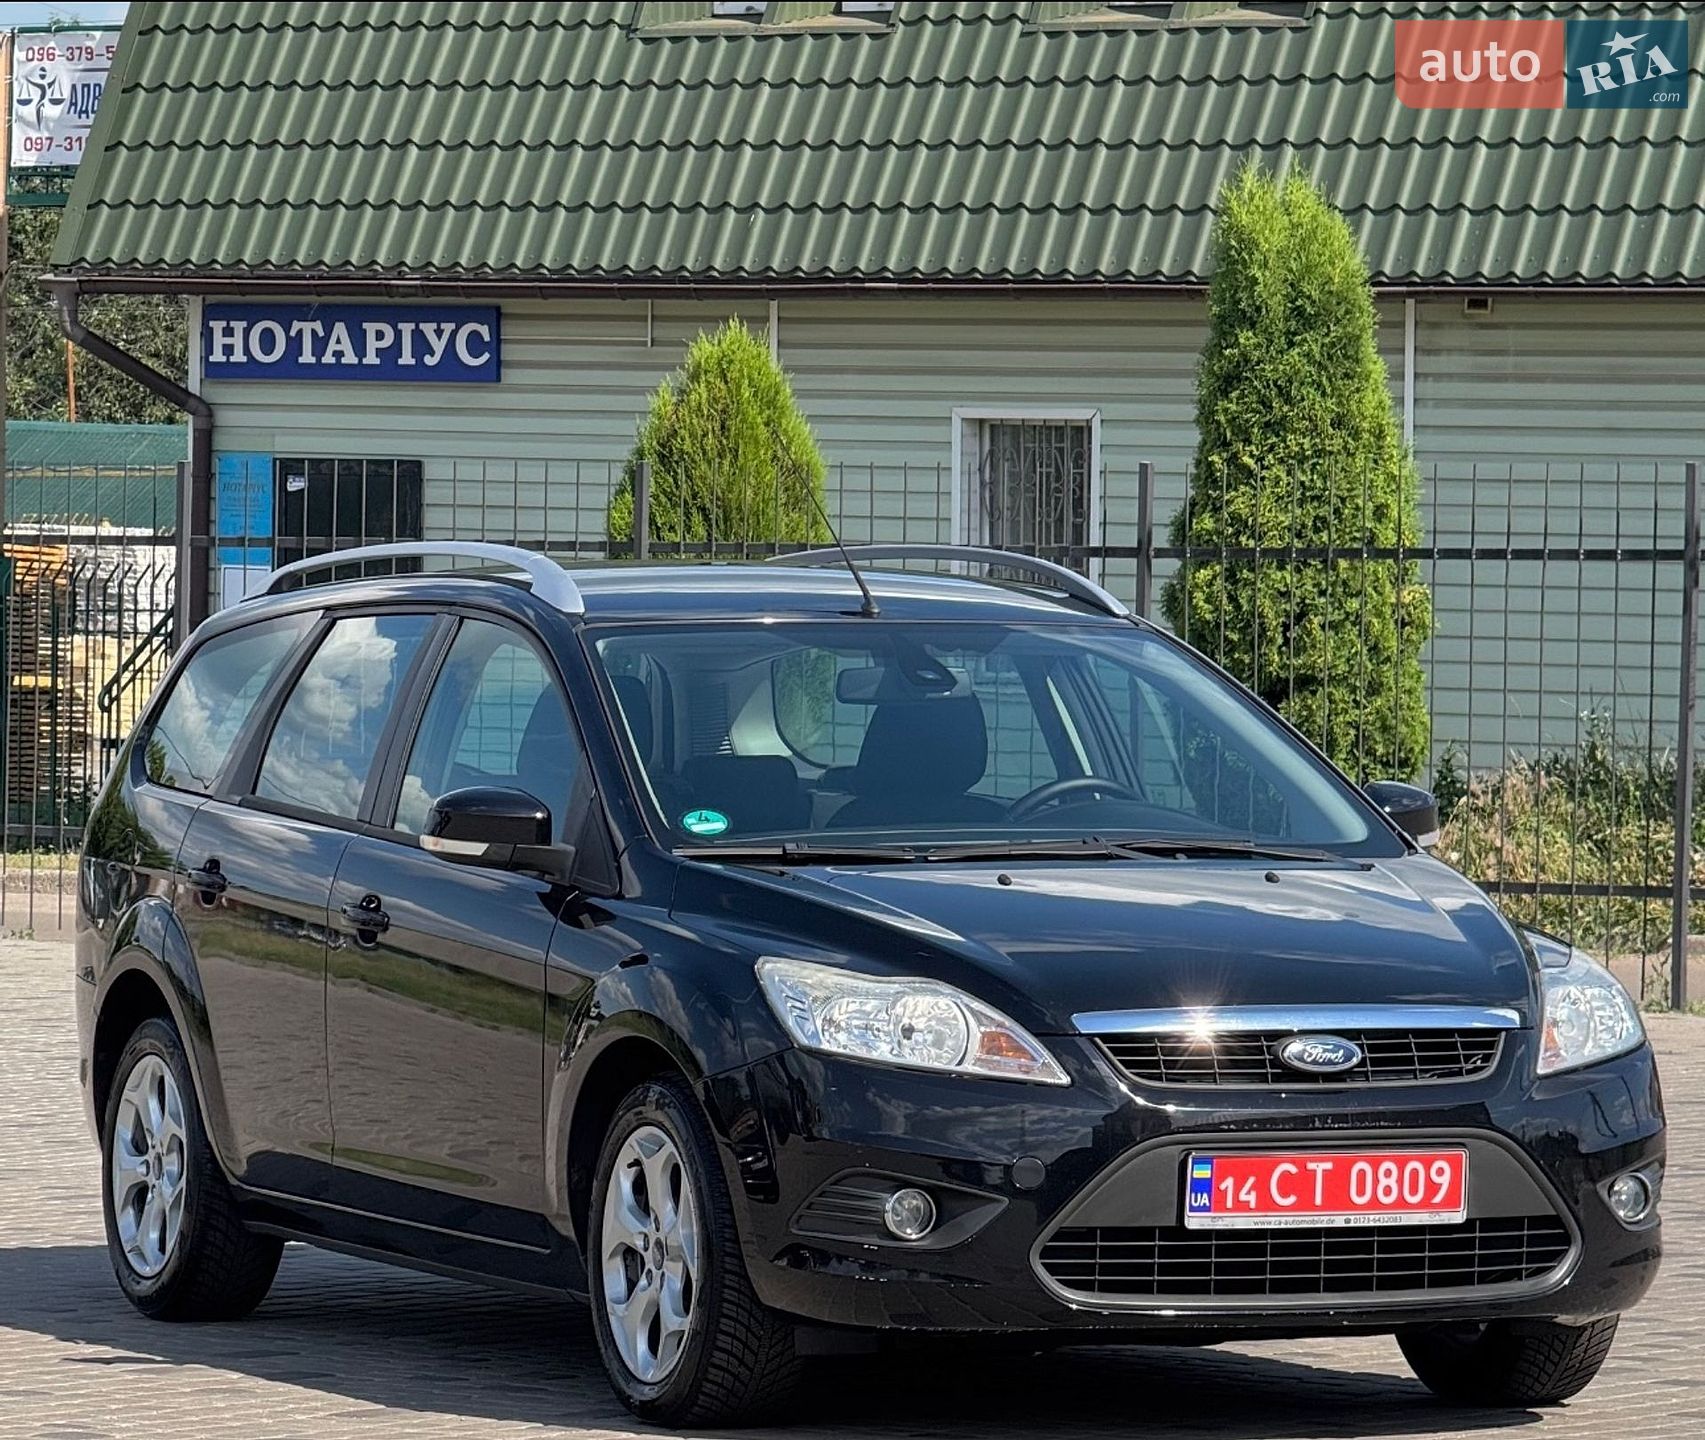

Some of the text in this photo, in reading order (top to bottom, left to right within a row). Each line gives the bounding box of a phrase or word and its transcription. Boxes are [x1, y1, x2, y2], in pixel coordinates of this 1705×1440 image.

[208, 320, 491, 367] НОТАРІУС
[1303, 1043, 1345, 1063] Ford
[1218, 1160, 1452, 1209] 14 CT 0809
[1191, 1193, 1211, 1208] UA
[1252, 1217, 1336, 1227] www.ca-automobile.de
